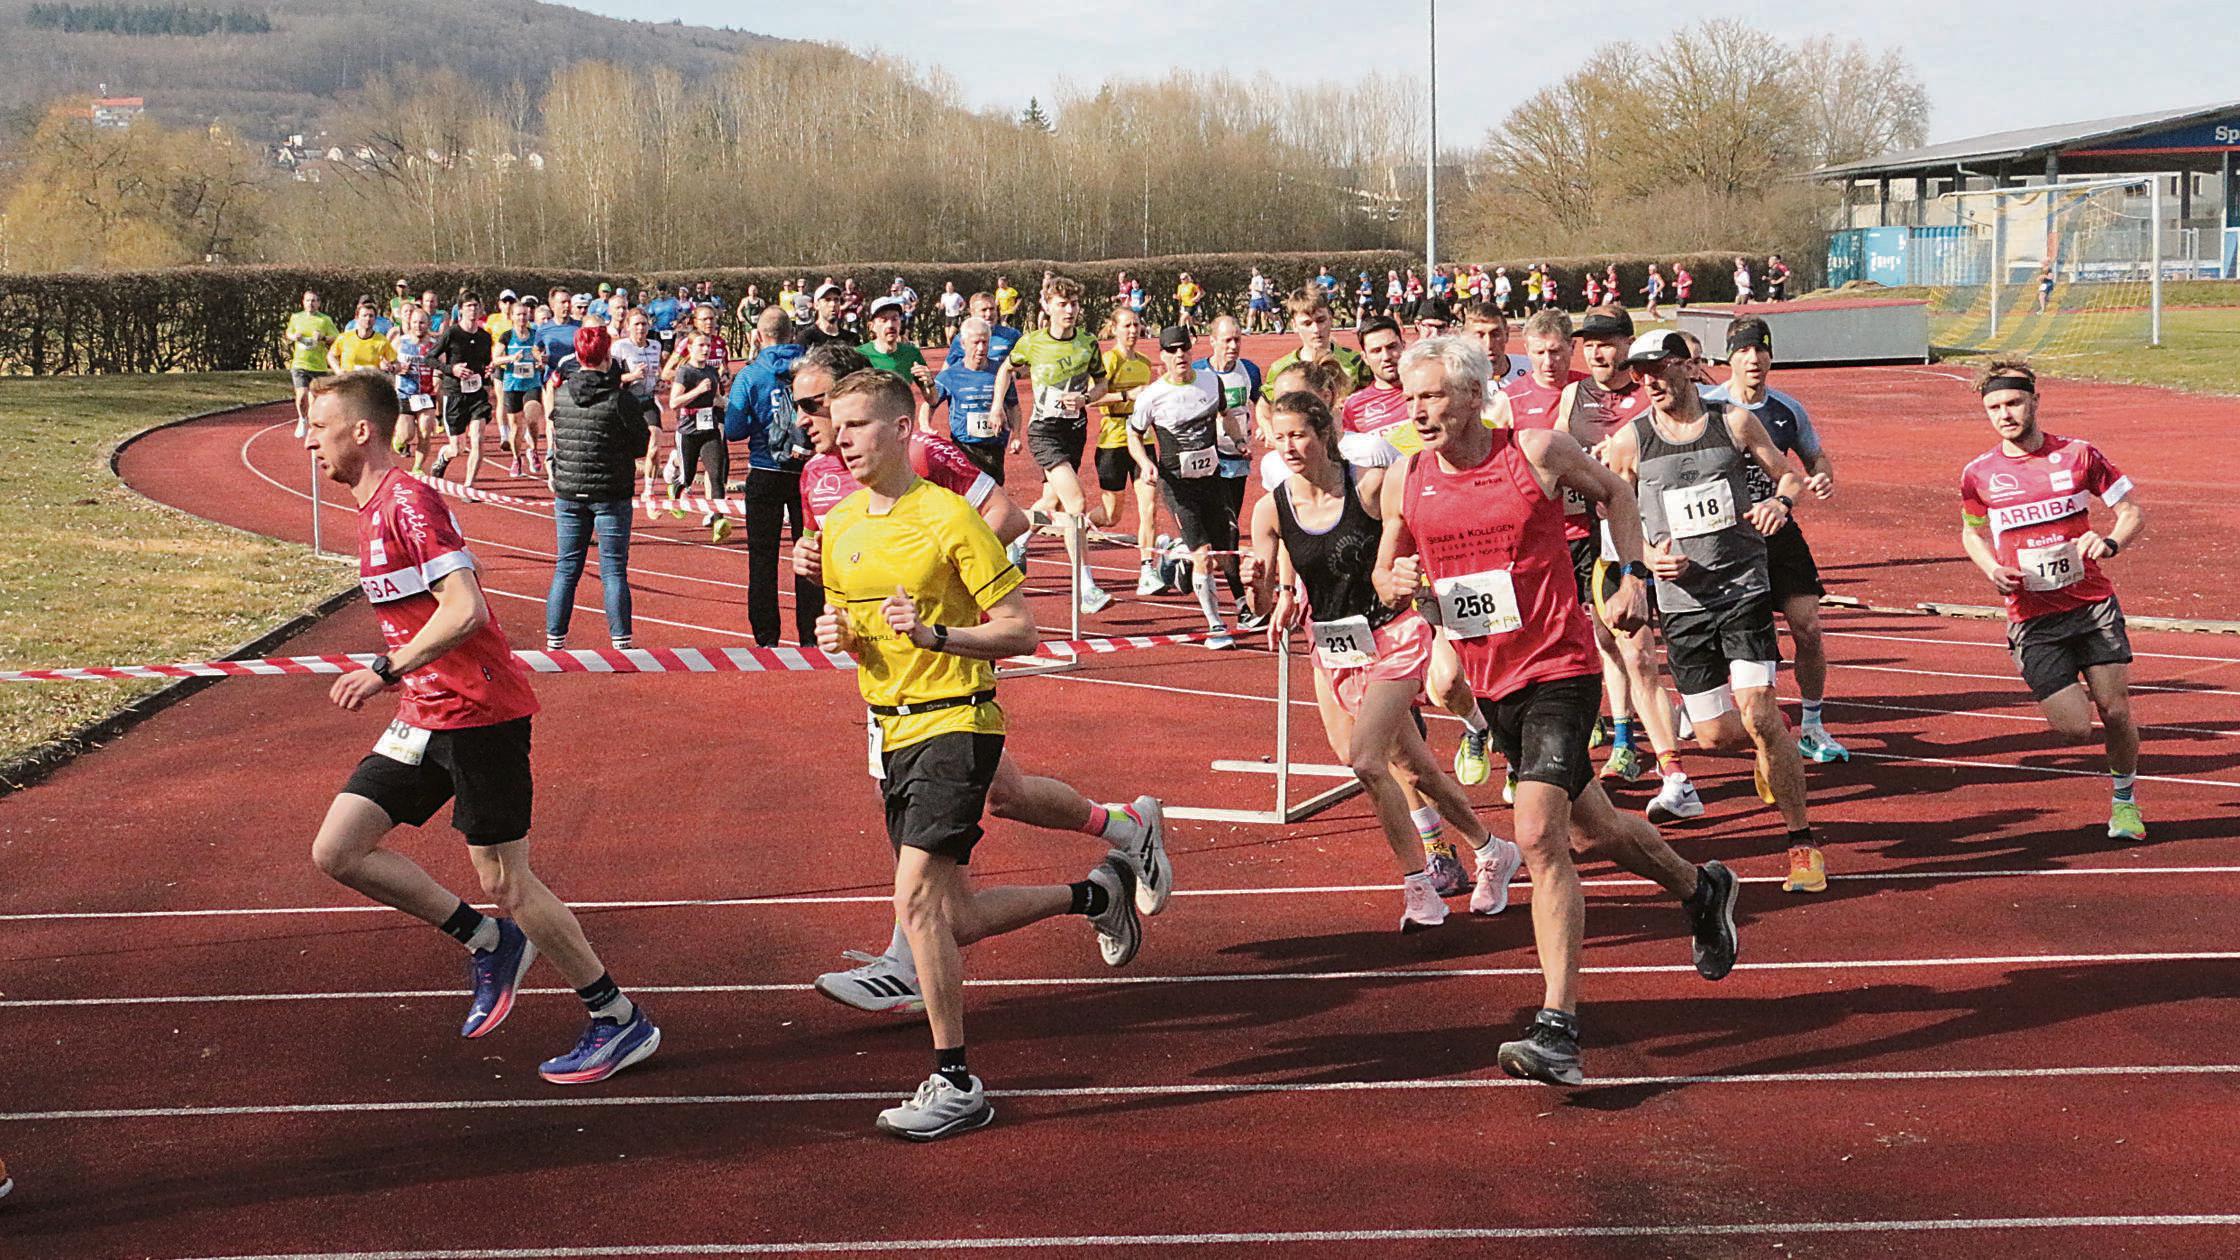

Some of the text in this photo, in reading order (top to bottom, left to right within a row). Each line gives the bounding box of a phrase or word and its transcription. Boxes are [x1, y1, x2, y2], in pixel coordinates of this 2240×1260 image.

[1057, 356, 1072, 369] TV
[976, 420, 992, 430] 13
[1191, 458, 1211, 470] 122
[1474, 478, 1502, 487] Markus
[1684, 498, 1719, 519] 118
[2000, 498, 2076, 525] ARRIBA
[1467, 525, 1515, 537] KOLLEGEN
[2037, 558, 2070, 578] 178
[1454, 593, 1496, 618] 258
[1326, 634, 1357, 653] 231
